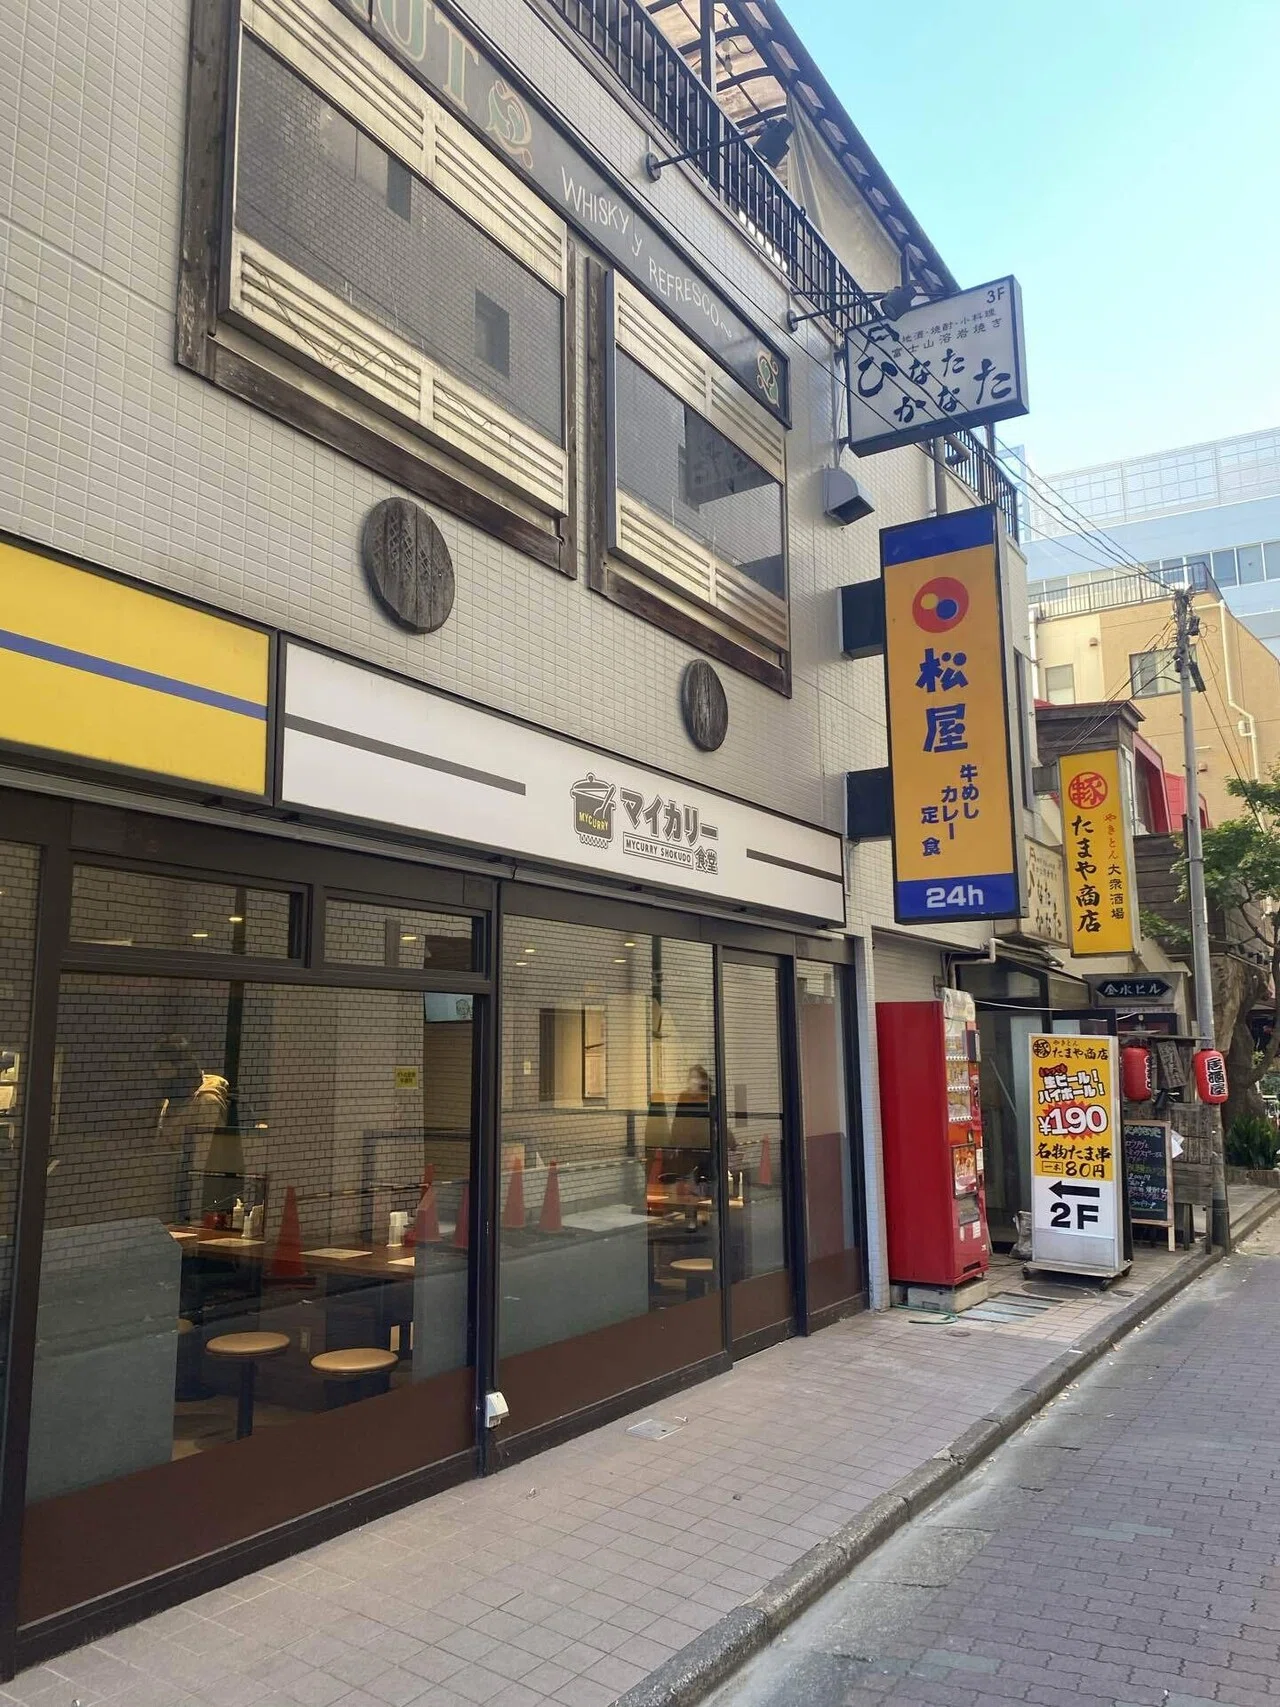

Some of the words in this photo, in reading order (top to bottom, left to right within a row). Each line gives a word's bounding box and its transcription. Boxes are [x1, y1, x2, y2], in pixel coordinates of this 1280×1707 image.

[559, 166, 632, 234] WHISKY
[986, 285, 1006, 305] 3F
[891, 318, 1004, 358] 富士山溶岩焼き
[915, 647, 970, 754] 松屋
[959, 764, 980, 820] 牛めし
[578, 811, 610, 832] MYCURRY
[619, 787, 719, 847] マイカリー
[694, 846, 719, 875] 食堂
[920, 805, 942, 857] 定食
[940, 786, 960, 841] カレー
[626, 840, 658, 856] MYCURRY
[660, 848, 692, 864] SHOKUDO
[1103, 812, 1119, 861] やきとん
[1071, 814, 1103, 934] たまや商店
[1107, 863, 1126, 921] 大衆酒場
[925, 884, 985, 909] 24h
[1052, 1047, 1109, 1061] たまや商店
[1037, 1105, 1109, 1137] ¥190
[1035, 1142, 1112, 1163] 名物たま串
[1065, 1160, 1105, 1178] 80円
[1050, 1202, 1100, 1230] 2F
